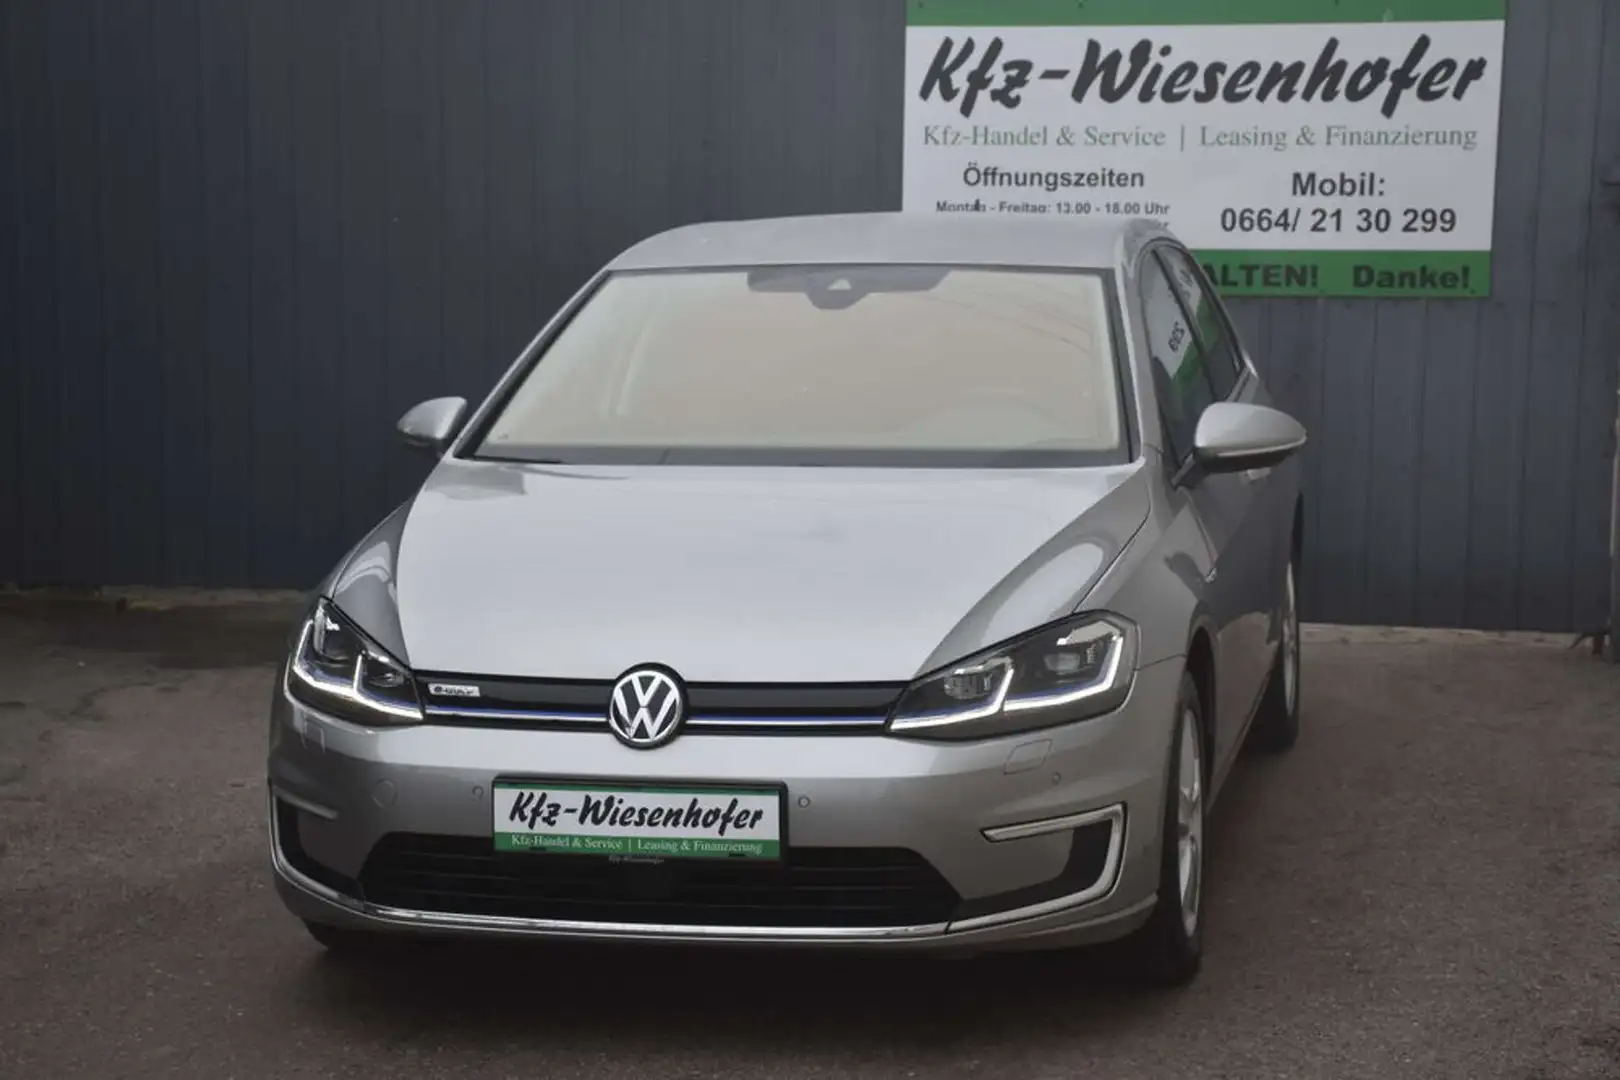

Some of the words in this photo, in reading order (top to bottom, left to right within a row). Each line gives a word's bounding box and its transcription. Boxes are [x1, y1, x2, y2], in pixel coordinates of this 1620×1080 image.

[919, 34, 1487, 119] Kfz-Wiesenhofer
[924, 125, 1048, 147] Kfz-Handel
[1056, 126, 1076, 146] &
[1084, 125, 1166, 147] Service
[1200, 125, 1288, 151] Leasing
[1296, 125, 1316, 146] &
[1325, 125, 1478, 150] Finanzierung
[963, 161, 1145, 191] Öffnungszeiten
[1292, 172, 1386, 197] Mobil:
[1056, 202, 1091, 214] 13.00
[1105, 202, 1141, 215] 18.00
[1145, 202, 1170, 215] Uhr
[1220, 208, 1301, 232] 0664/
[1310, 208, 1343, 232] 21
[1357, 208, 1391, 232] 30
[1402, 208, 1457, 232] 299
[1353, 265, 1471, 289] Danke!
[509, 791, 764, 836] Kfz-Wiesenhofer
[511, 834, 570, 847] Kfz-Handel
[572, 837, 584, 849] &
[584, 837, 623, 849] Service
[637, 840, 678, 853] Leasing
[680, 841, 692, 852] &
[693, 841, 762, 854] Finanzierung
